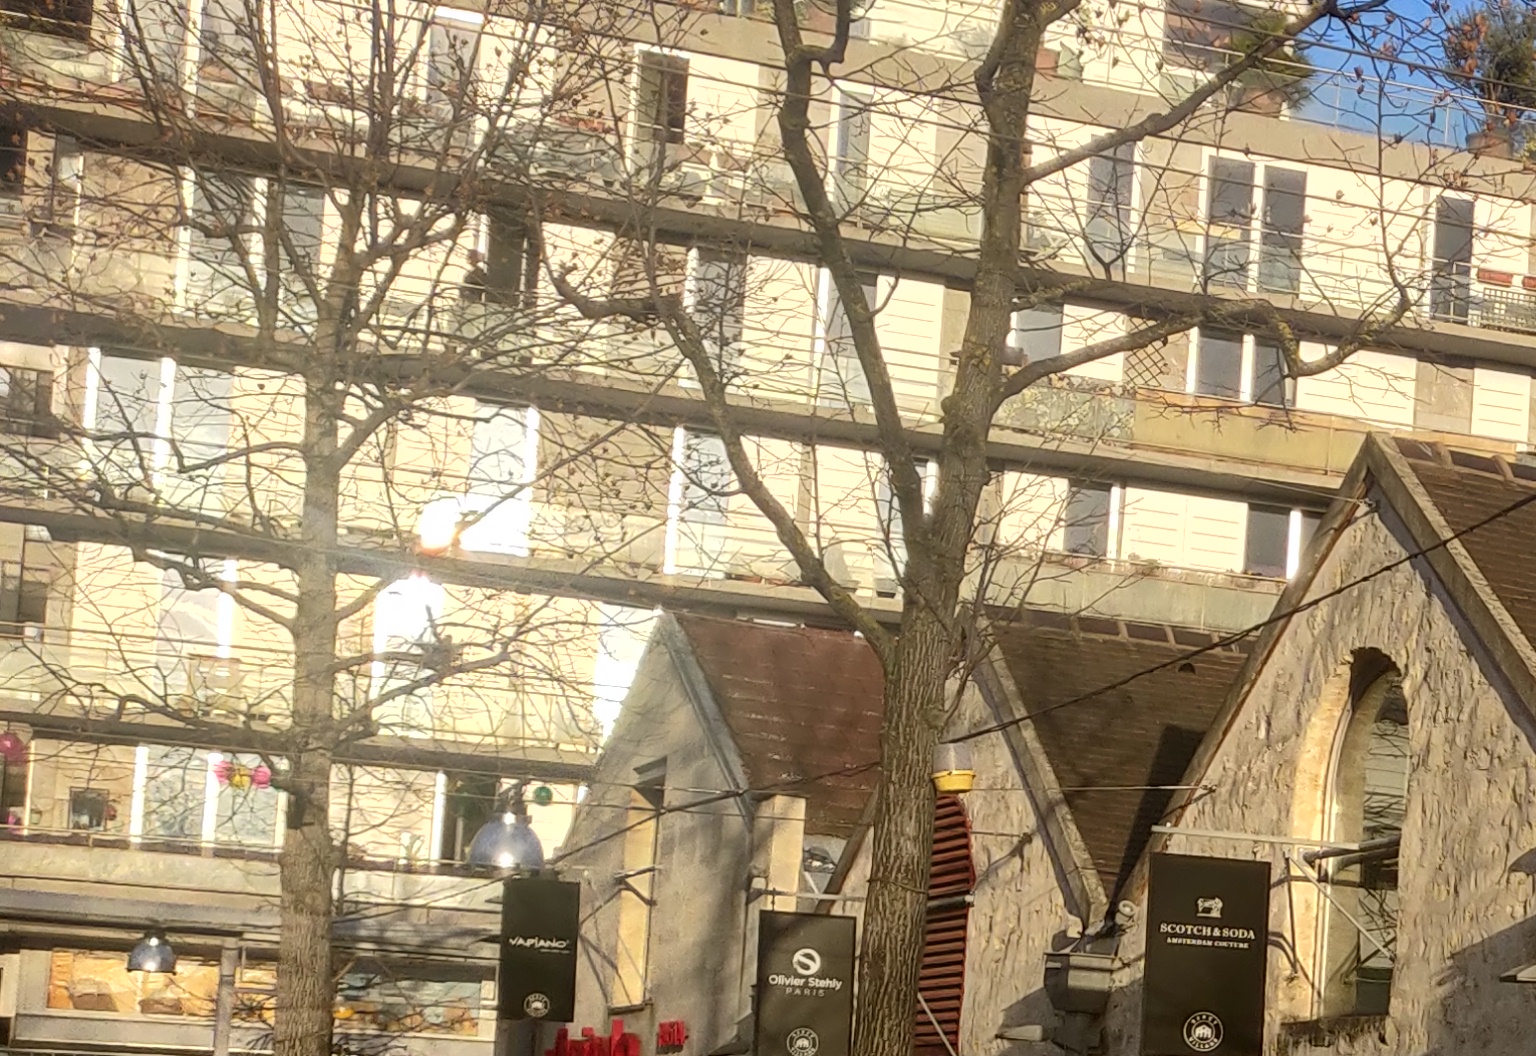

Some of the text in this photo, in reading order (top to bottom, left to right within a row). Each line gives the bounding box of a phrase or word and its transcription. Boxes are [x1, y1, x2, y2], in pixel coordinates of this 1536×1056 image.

[768, 974, 842, 991] Olivier Stehly
[785, 987, 825, 997] PARIS
